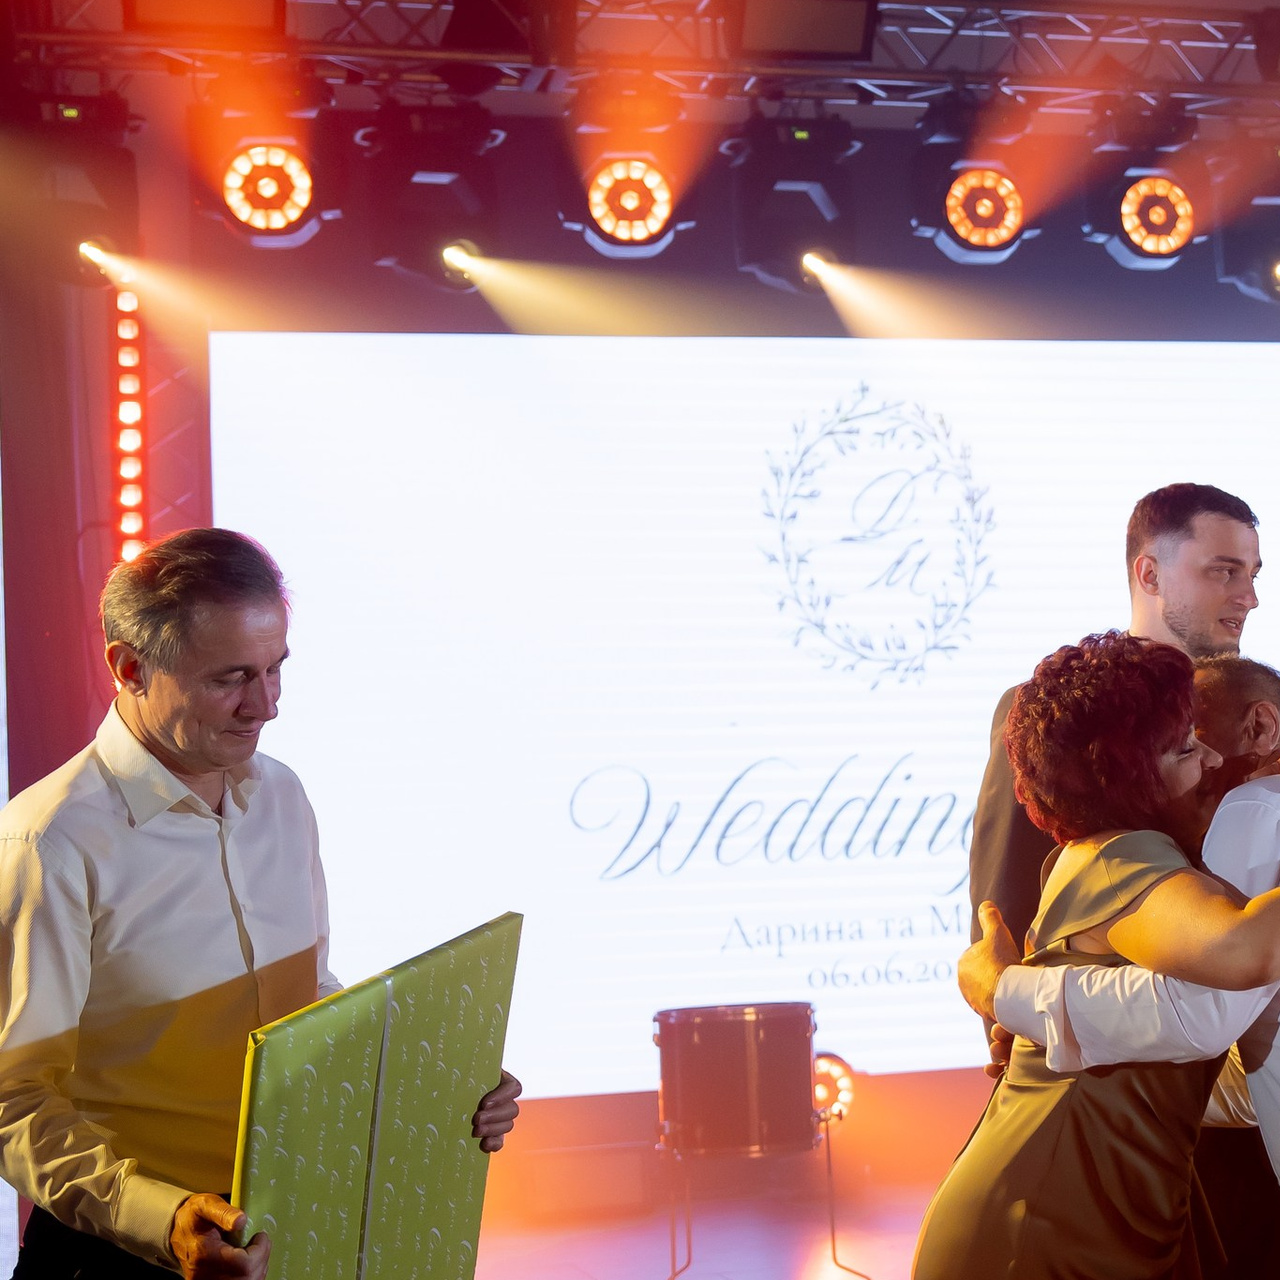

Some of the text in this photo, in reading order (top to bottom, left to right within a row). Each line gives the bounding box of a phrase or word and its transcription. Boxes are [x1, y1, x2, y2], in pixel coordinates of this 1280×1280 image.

[720, 915, 865, 958] Дарина
[877, 915, 915, 939] та
[806, 950, 954, 989] 06.06.20
